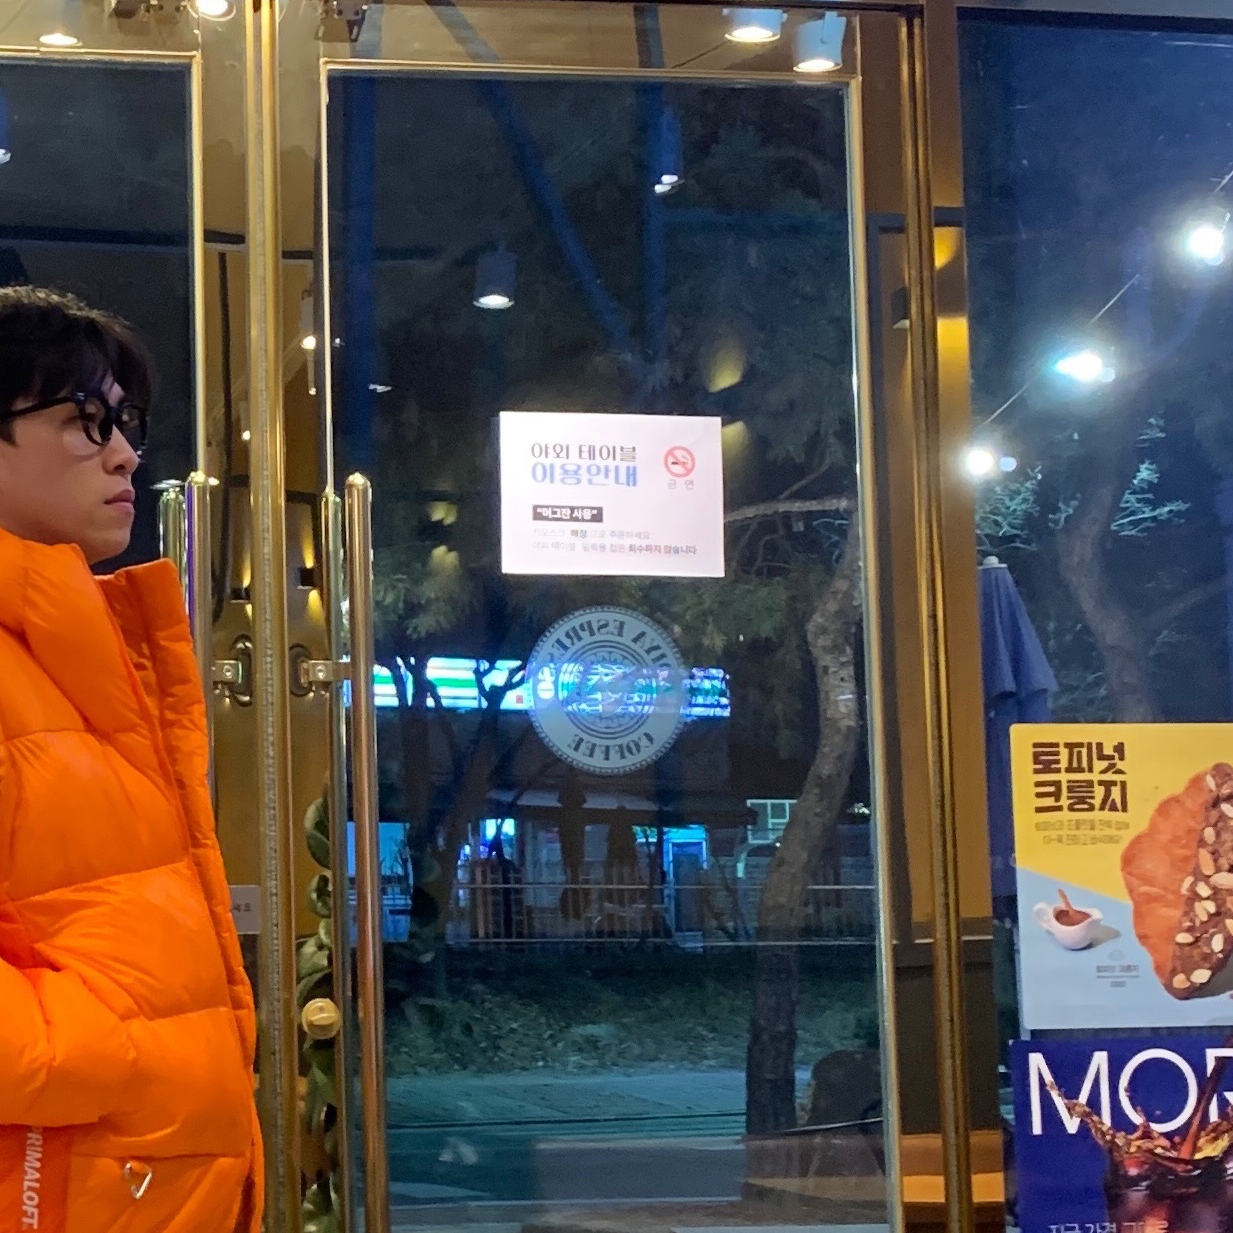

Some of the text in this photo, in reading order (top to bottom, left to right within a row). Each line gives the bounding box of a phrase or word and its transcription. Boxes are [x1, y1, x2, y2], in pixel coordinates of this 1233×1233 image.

[531, 443, 636, 462] 야외 테이블
[531, 462, 637, 487] 이용안내
[1032, 742, 1127, 775] 토피넛
[1033, 779, 1128, 813] 크룽지
